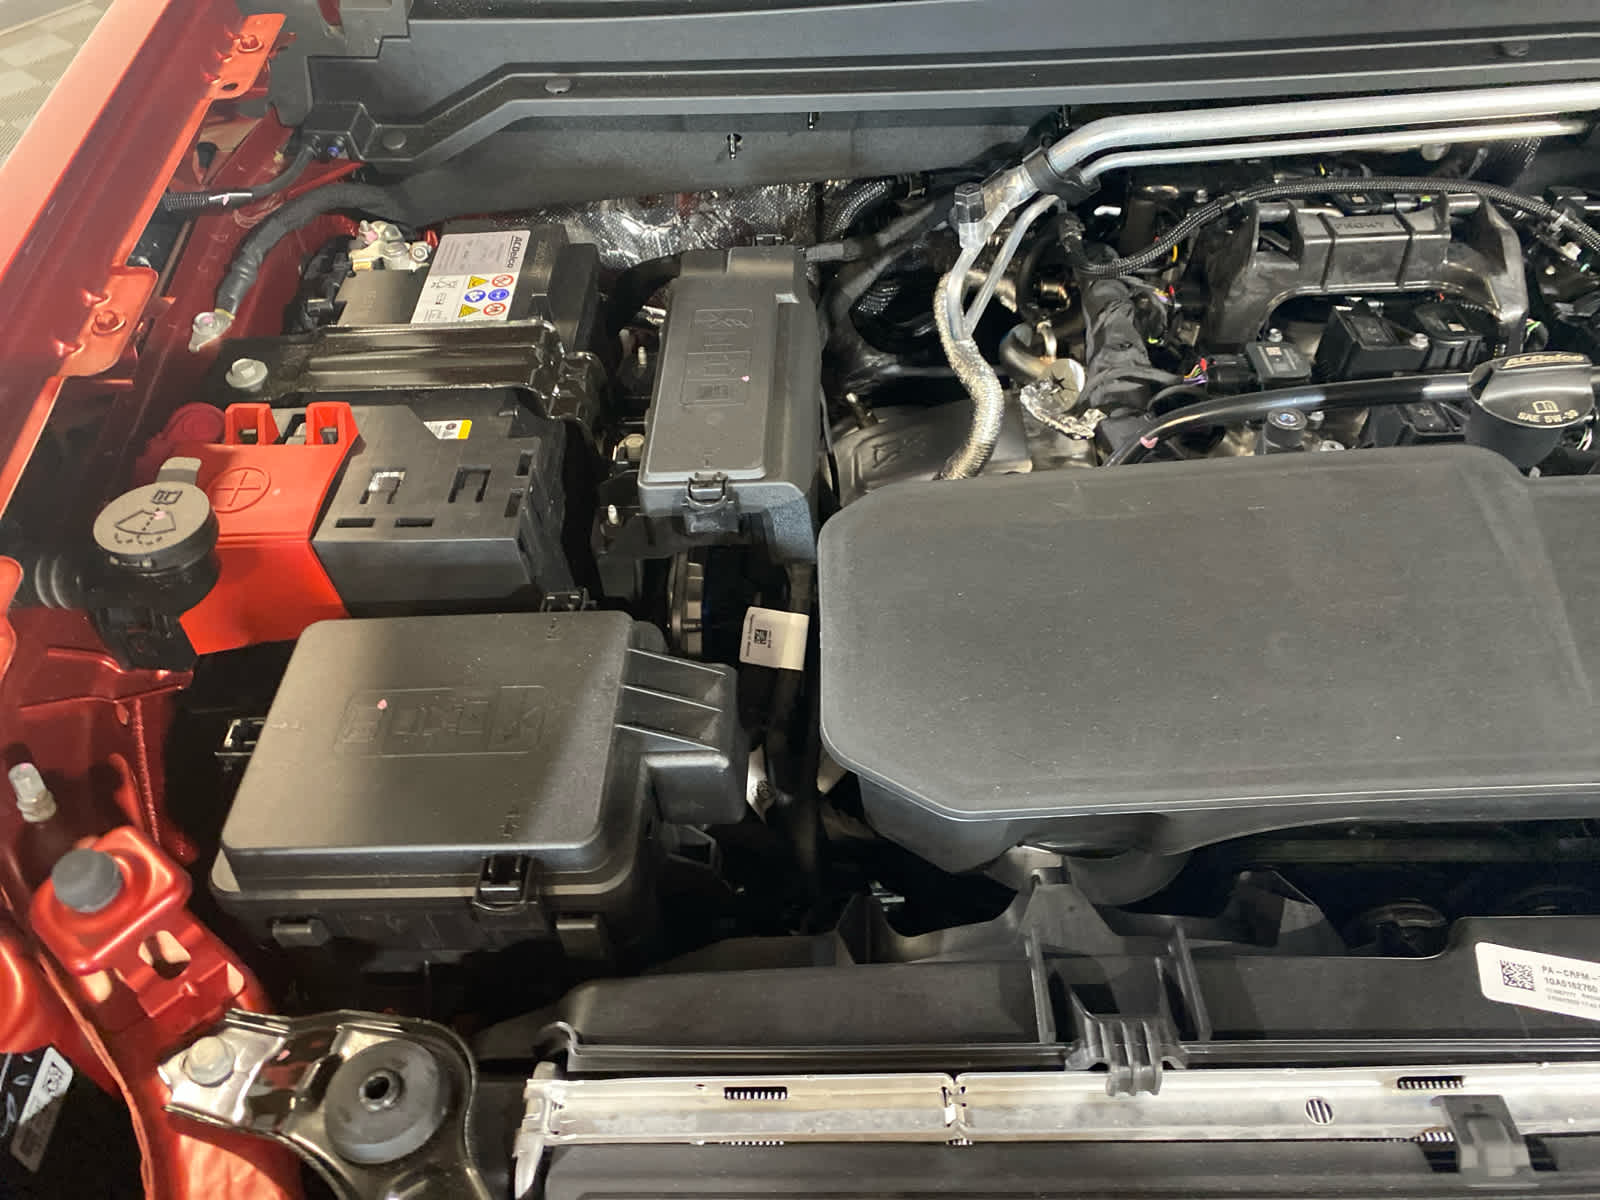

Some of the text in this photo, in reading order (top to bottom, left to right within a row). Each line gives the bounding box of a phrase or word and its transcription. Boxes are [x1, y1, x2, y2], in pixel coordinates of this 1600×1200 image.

[507, 236, 523, 268] ACDelco
[1502, 354, 1584, 368] ACDelco
[1517, 411, 1541, 423] SAE
